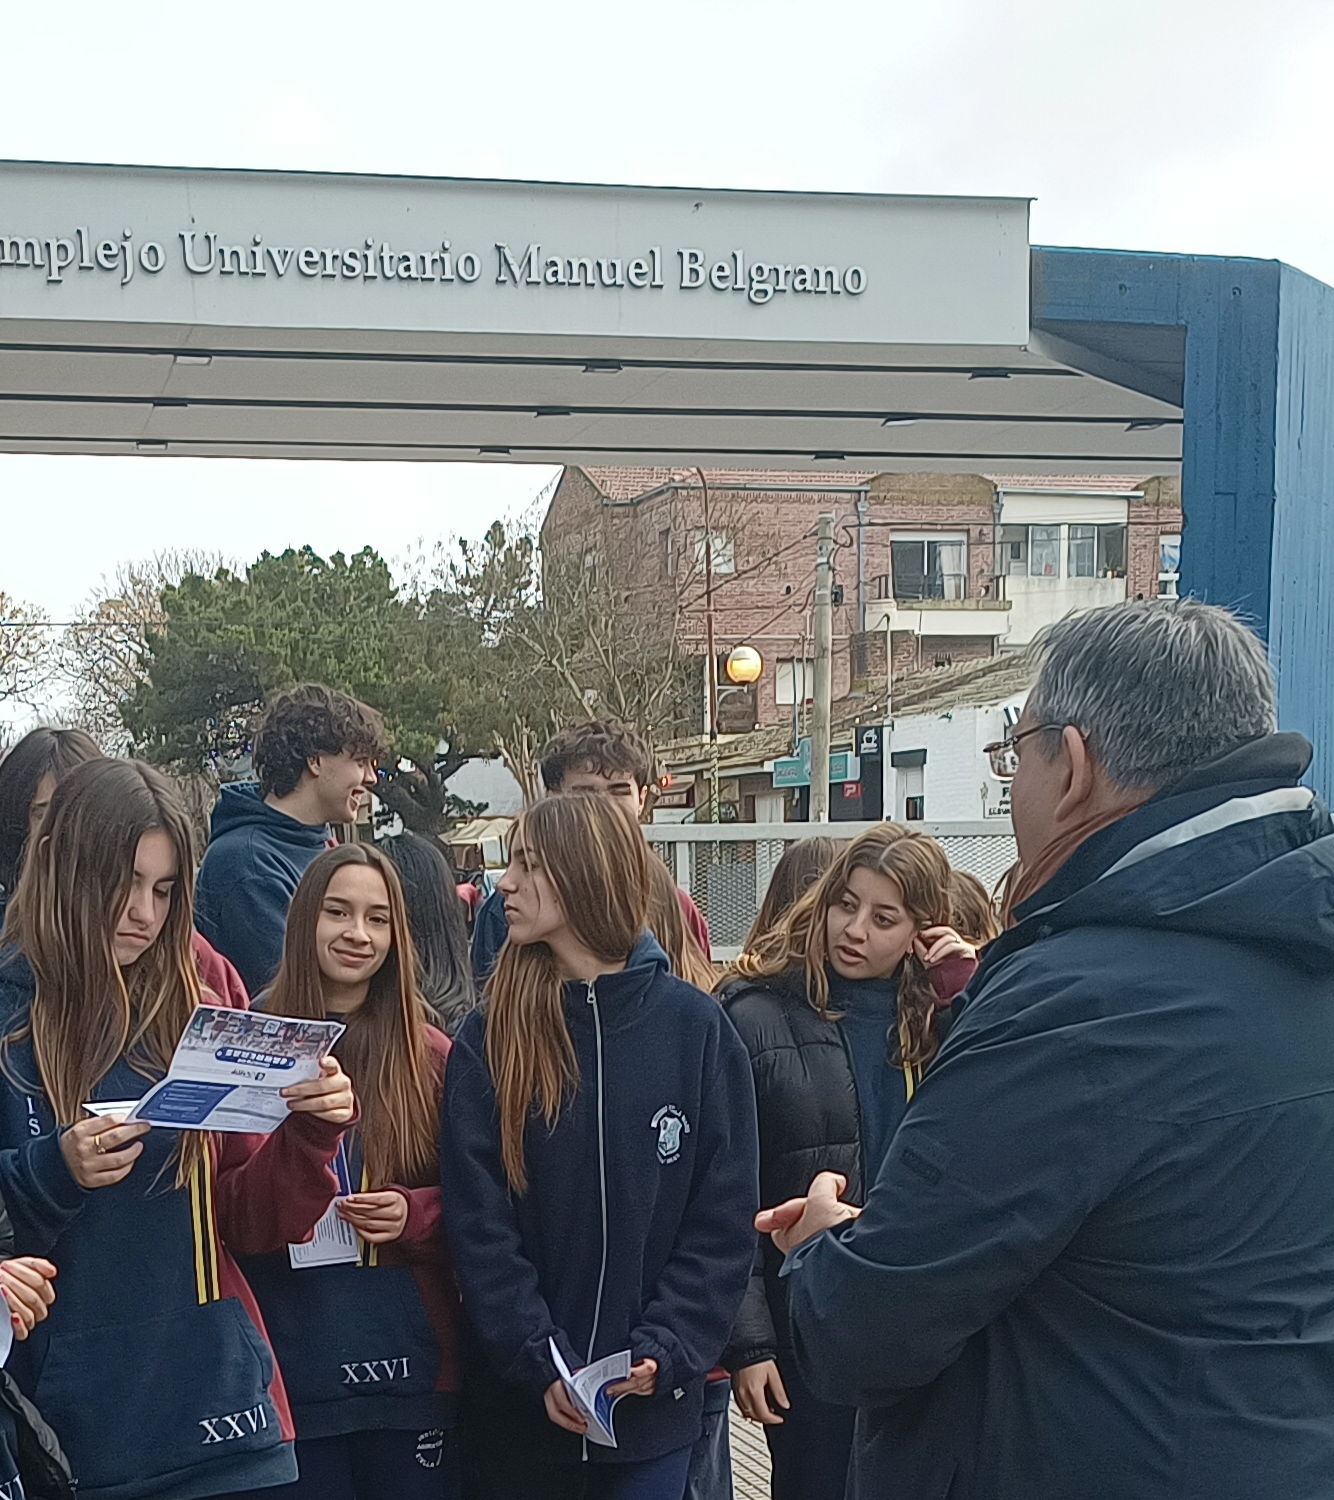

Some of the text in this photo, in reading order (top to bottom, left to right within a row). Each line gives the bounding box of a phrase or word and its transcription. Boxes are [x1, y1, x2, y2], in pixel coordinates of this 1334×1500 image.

[178, 229, 483, 283] Universitario
[494, 242, 665, 290] Manuel
[677, 247, 868, 306] Belgrano
[340, 1356, 411, 1385] XXVI
[198, 1403, 268, 1445] XXVI
